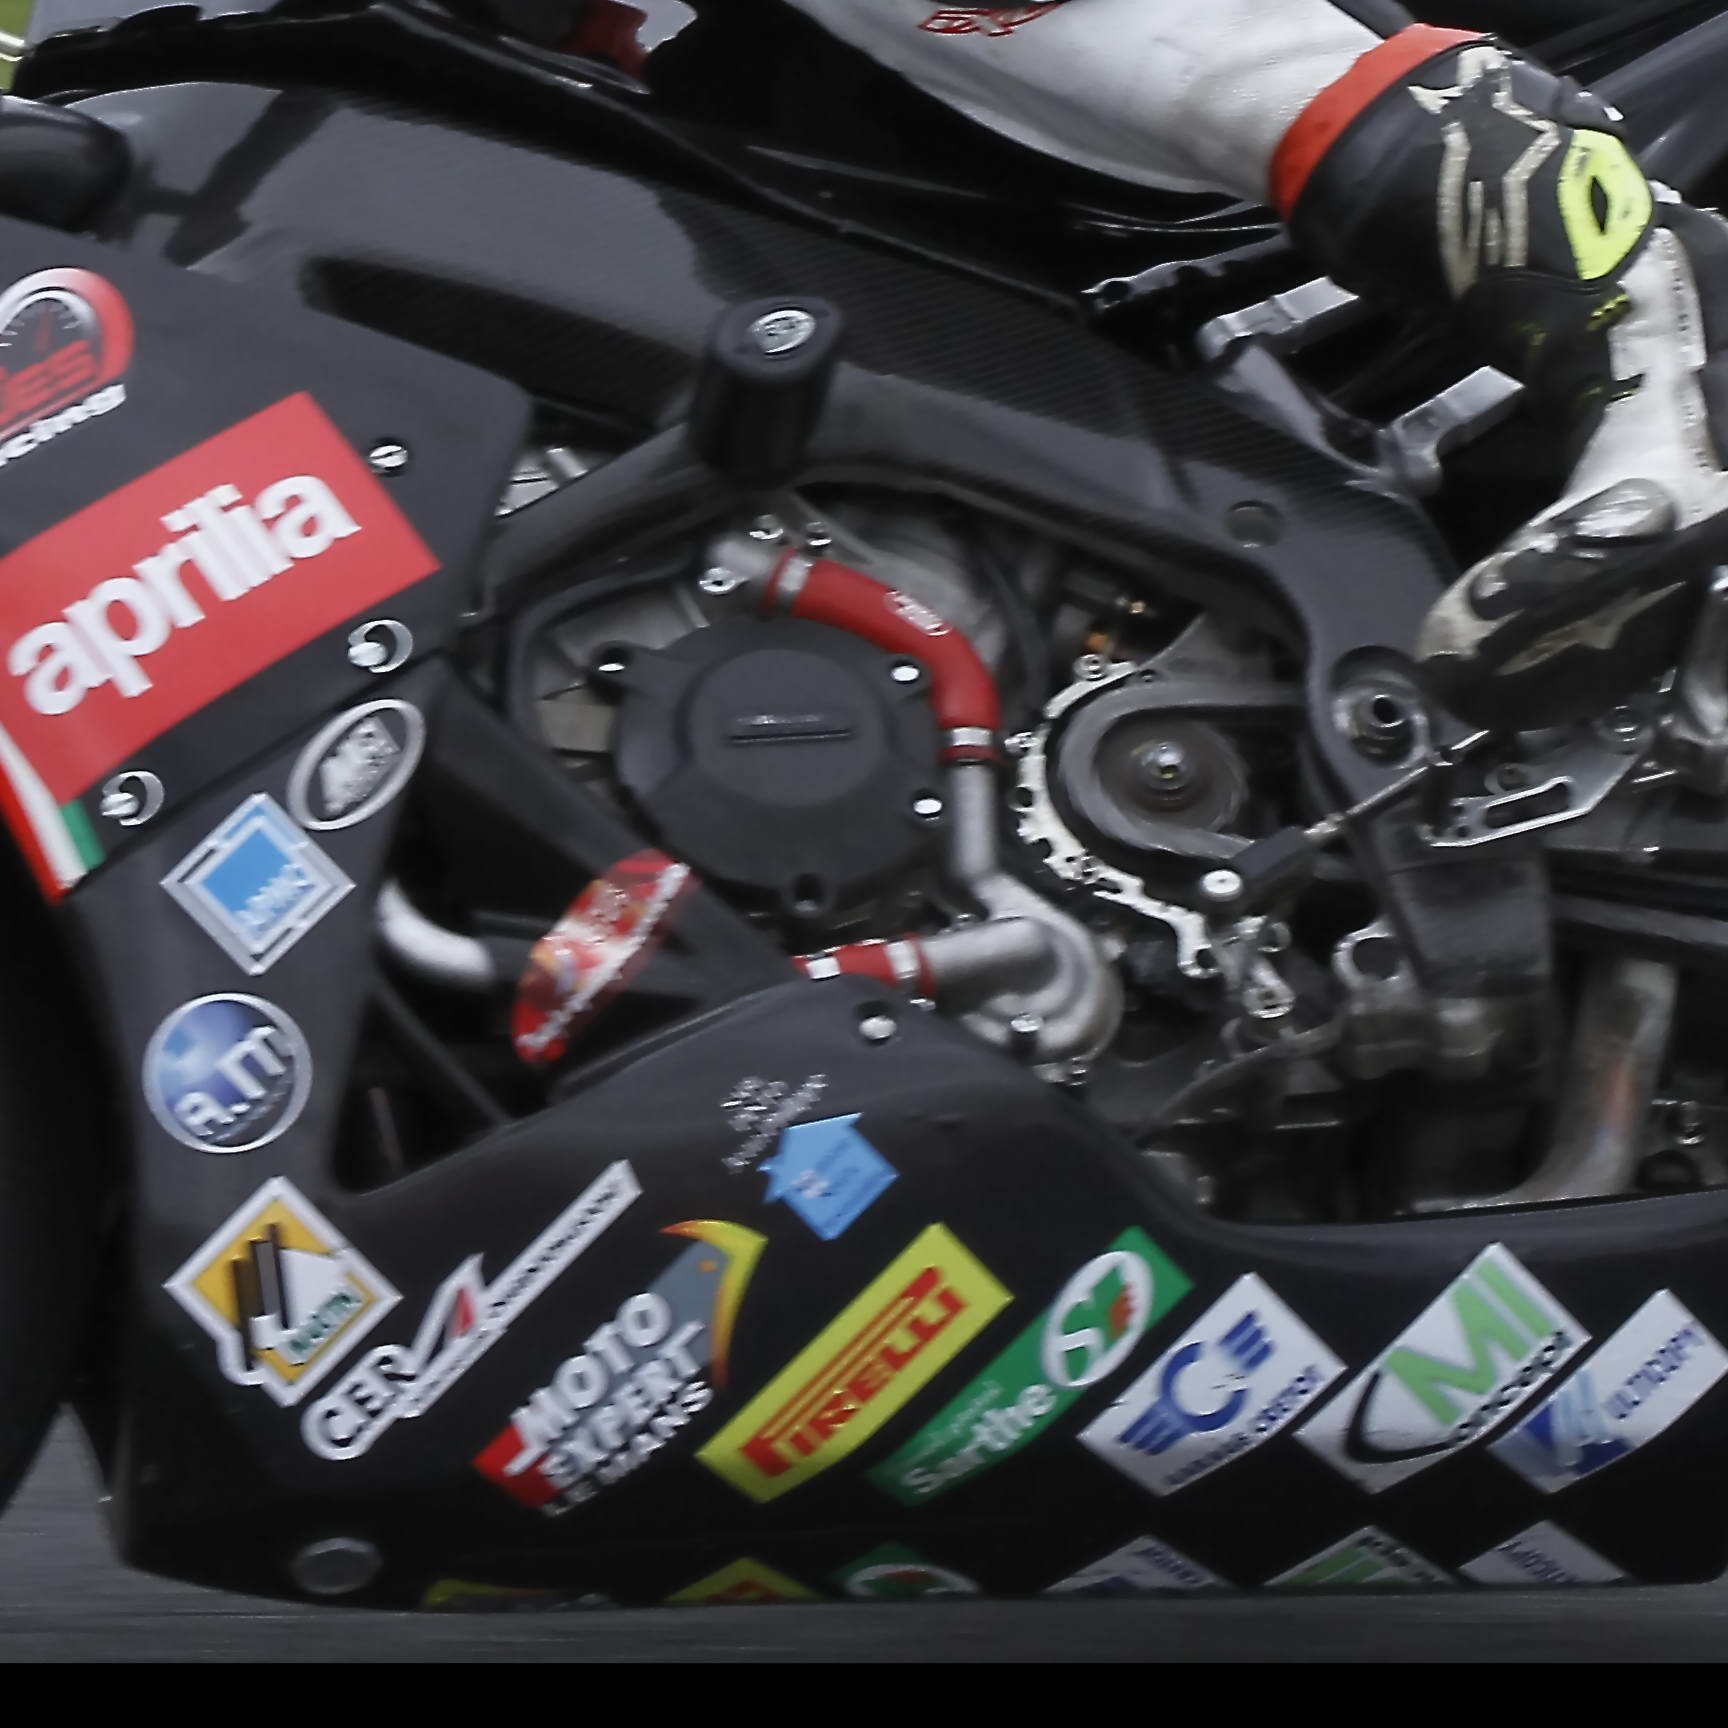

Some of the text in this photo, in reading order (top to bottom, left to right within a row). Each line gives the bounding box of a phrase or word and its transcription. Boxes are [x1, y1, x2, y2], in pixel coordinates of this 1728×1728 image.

[8, 474, 363, 716] aprilia
[504, 1292, 674, 1475] MOTO
[538, 1321, 707, 1493] EXPERT
[598, 1379, 714, 1485] MANS
[737, 1267, 967, 1479] PIRELLI
[901, 1383, 1057, 1494] Sarthe
